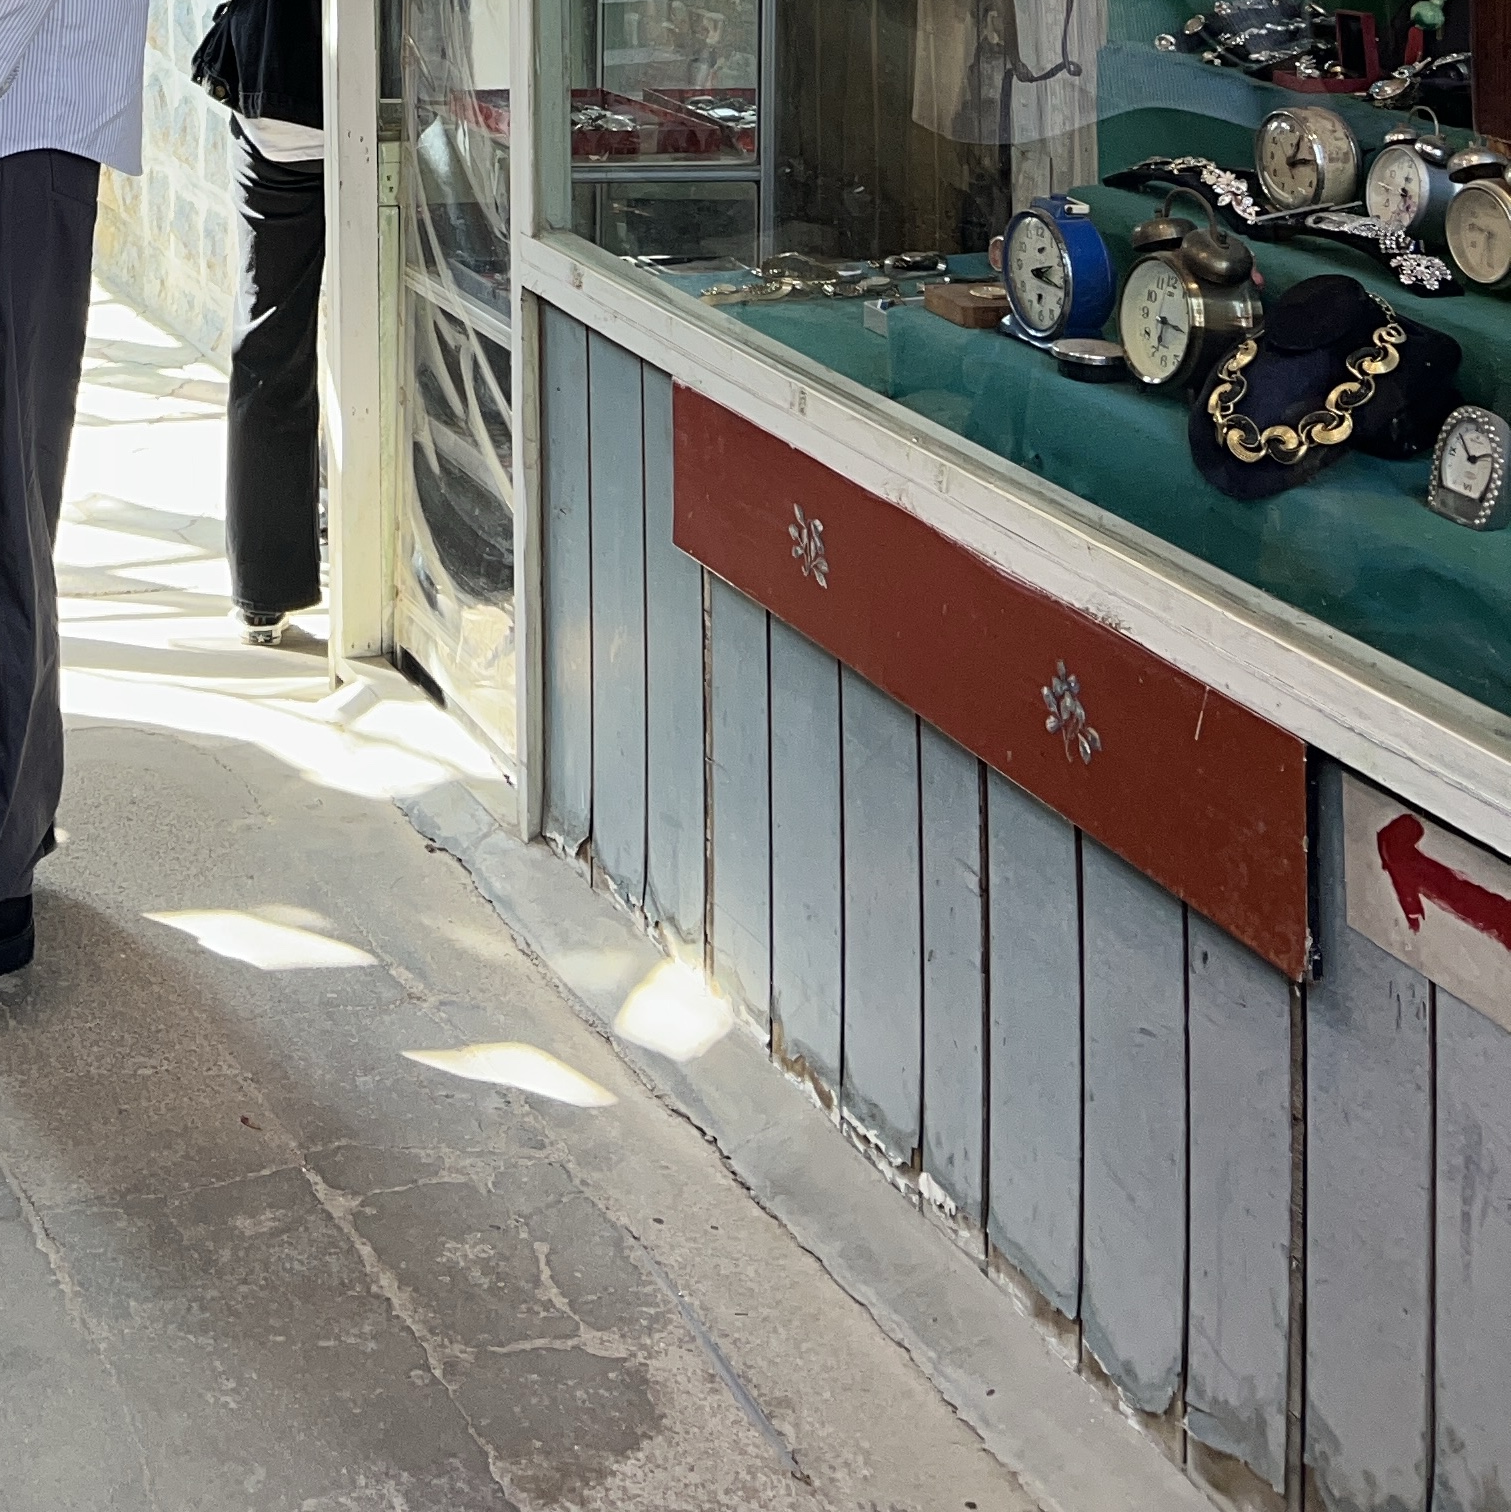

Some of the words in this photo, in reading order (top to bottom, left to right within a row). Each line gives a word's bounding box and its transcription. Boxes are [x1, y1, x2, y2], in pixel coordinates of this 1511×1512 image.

[1157, 276, 1164, 290] 11
[1167, 275, 1178, 289] 12
[1147, 289, 1157, 303] 10
[1151, 345, 1159, 357] 7
[1160, 355, 1167, 368] 6
